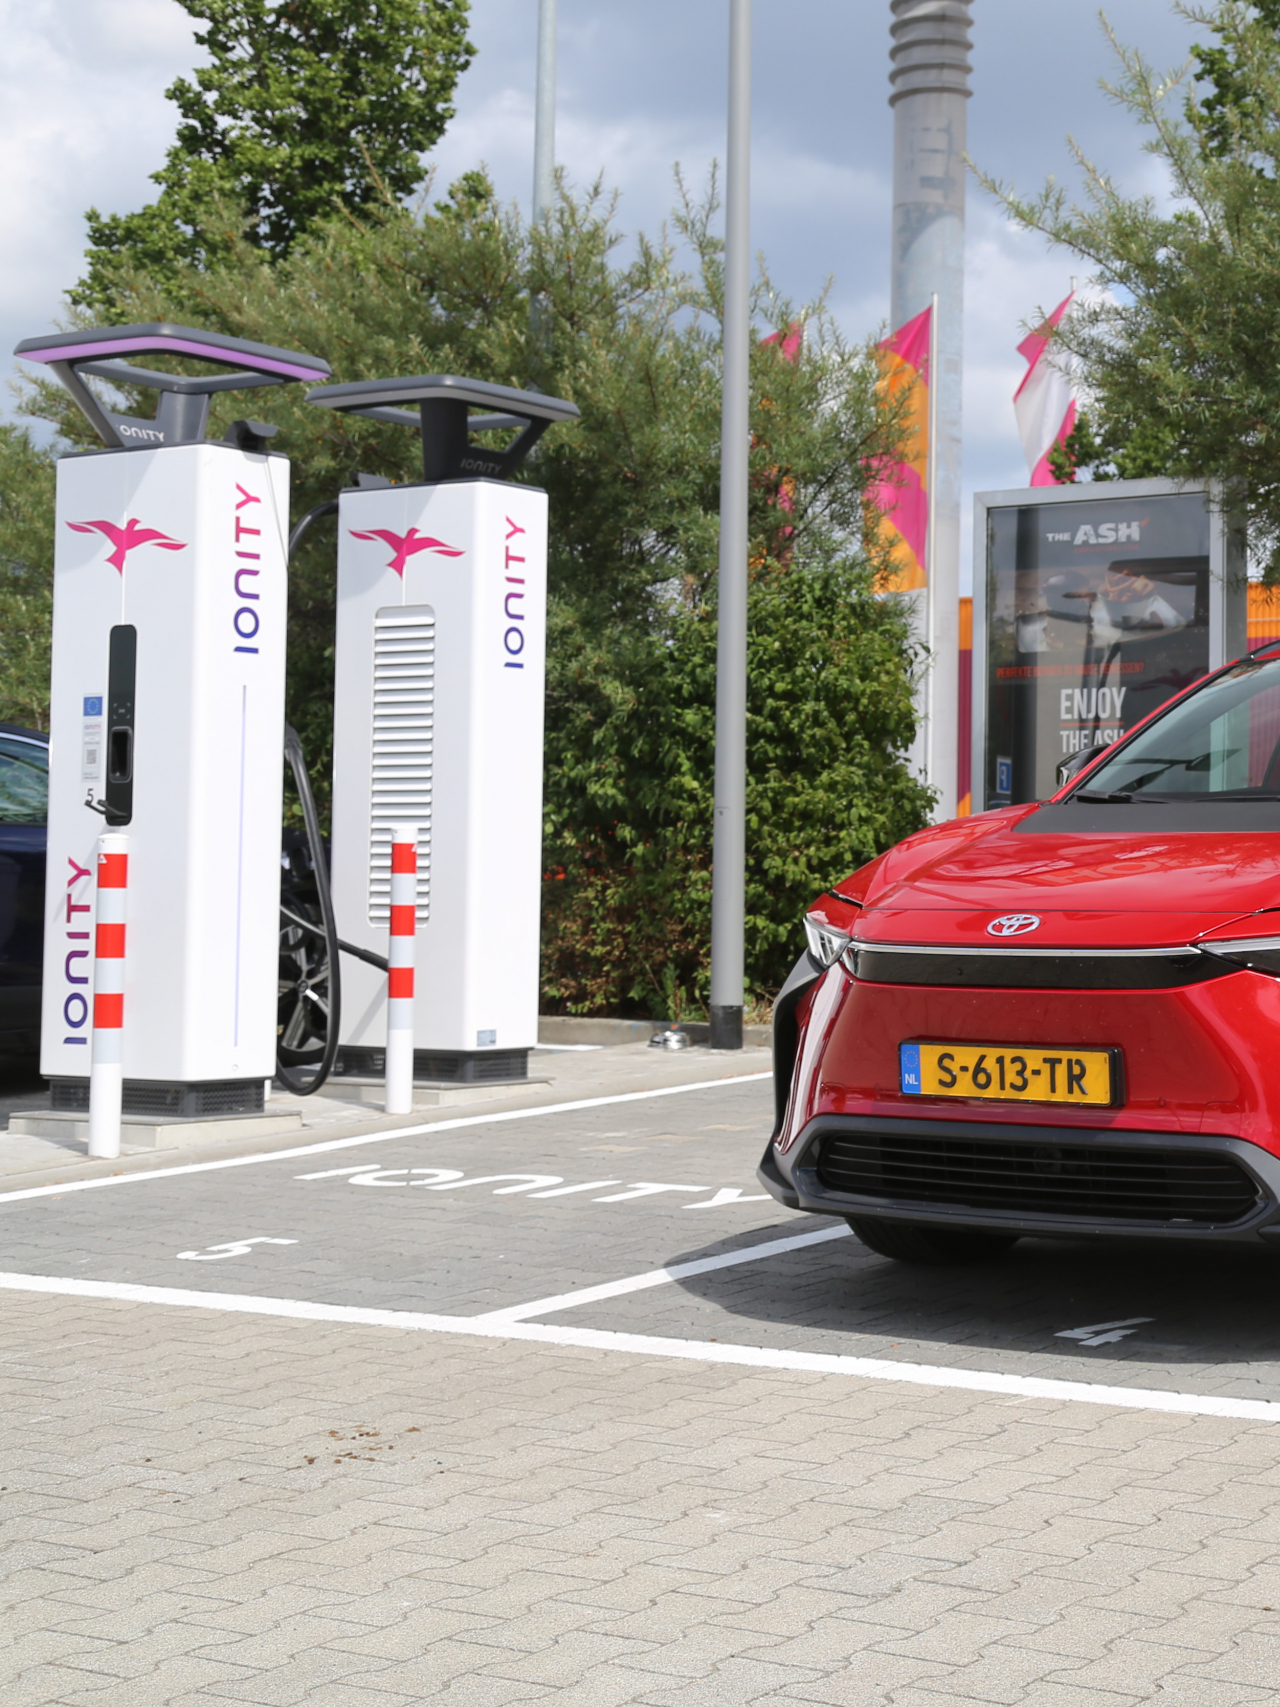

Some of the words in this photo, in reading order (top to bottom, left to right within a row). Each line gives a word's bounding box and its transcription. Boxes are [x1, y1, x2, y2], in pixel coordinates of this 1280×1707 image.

[460, 457, 503, 475] IONITY
[1046, 531, 1072, 543] THE
[1073, 520, 1140, 546] ASH
[233, 481, 262, 655] IONITY
[503, 514, 527, 670] IONITY
[1060, 686, 1127, 720] ENJOY
[1060, 729, 1090, 753] THE
[63, 856, 91, 1045] IONITY
[904, 1073, 919, 1085] NL
[937, 1052, 1089, 1096] S-613-TR
[293, 1163, 773, 1210] IONITY
[175, 1235, 299, 1262] 5
[1053, 1316, 1157, 1347] 4
